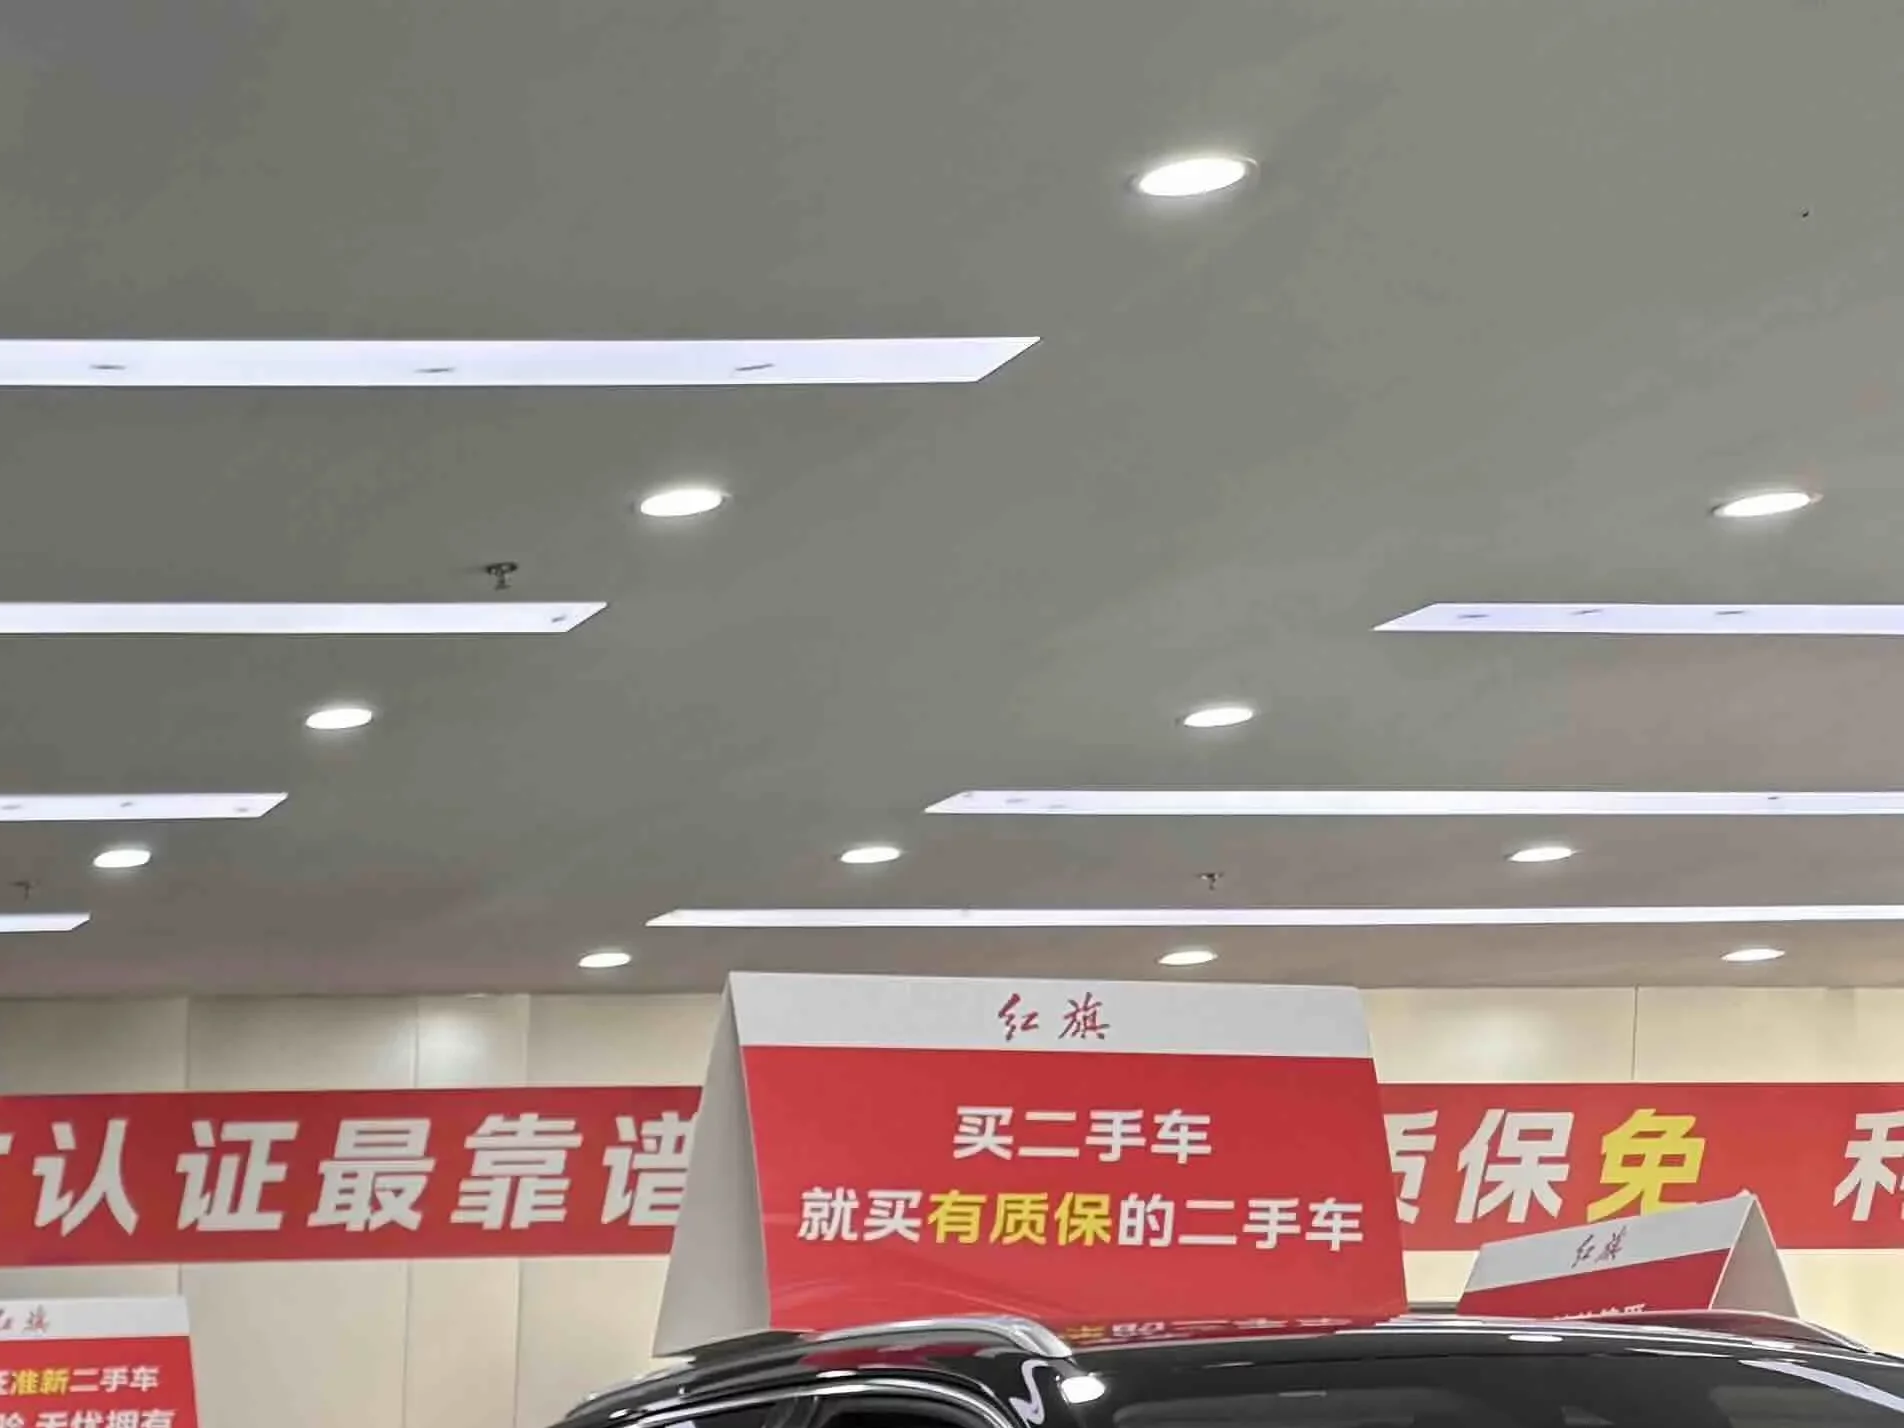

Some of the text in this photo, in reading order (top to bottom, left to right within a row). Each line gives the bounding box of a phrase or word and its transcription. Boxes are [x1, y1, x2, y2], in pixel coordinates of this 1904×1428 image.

[997, 992, 1111, 1042] 红旗
[952, 1105, 1213, 1165] 买二手车
[796, 1186, 1365, 1252] 就买有质保的二手车
